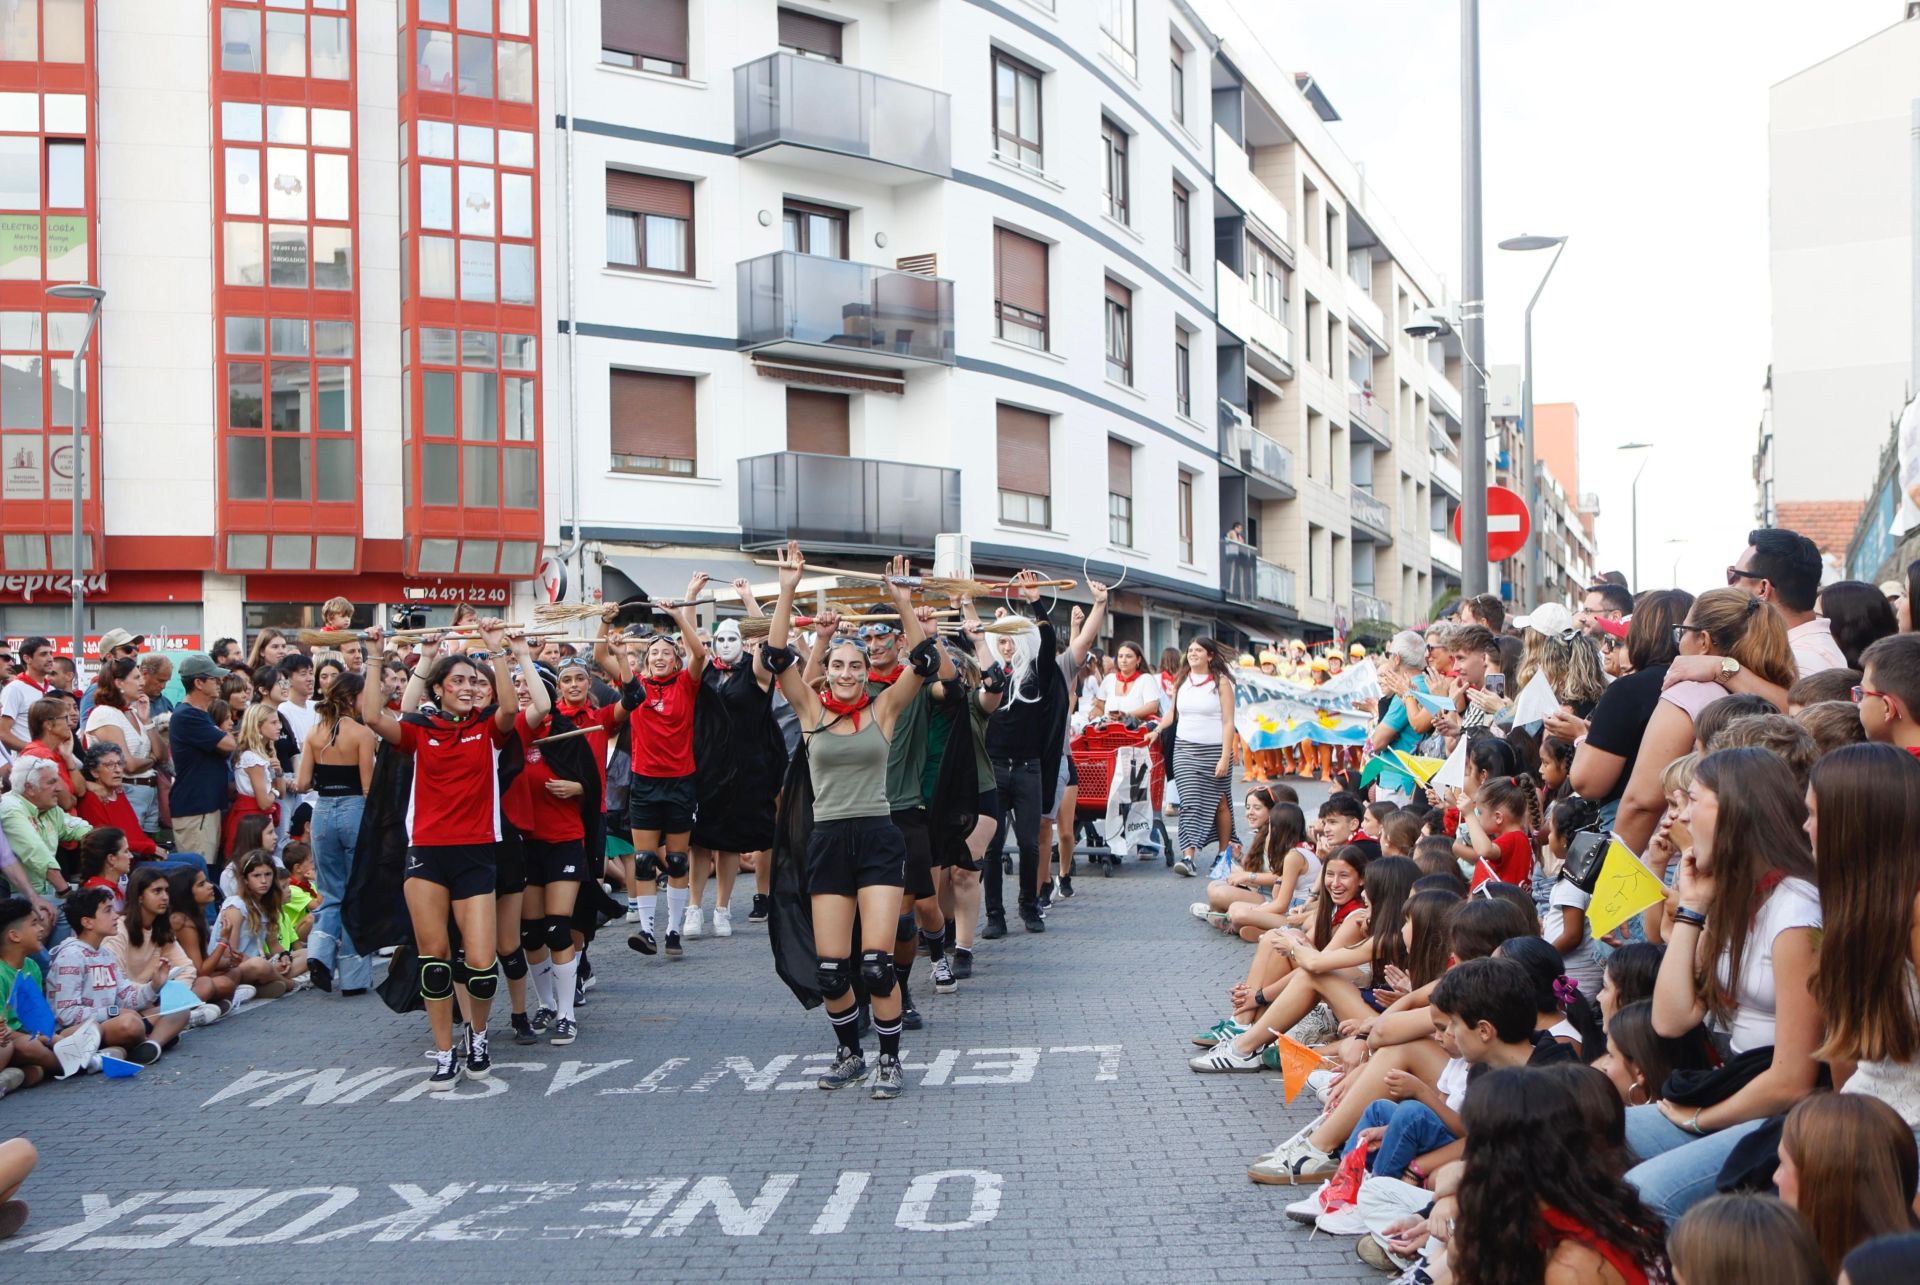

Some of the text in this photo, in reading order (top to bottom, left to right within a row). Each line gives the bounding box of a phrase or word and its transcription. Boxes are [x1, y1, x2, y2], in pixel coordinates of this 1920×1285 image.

[272, 256, 306, 264] ABOGADOS
[440, 587, 465, 601] 491
[468, 588, 486, 601] 22
[489, 588, 506, 602] 40
